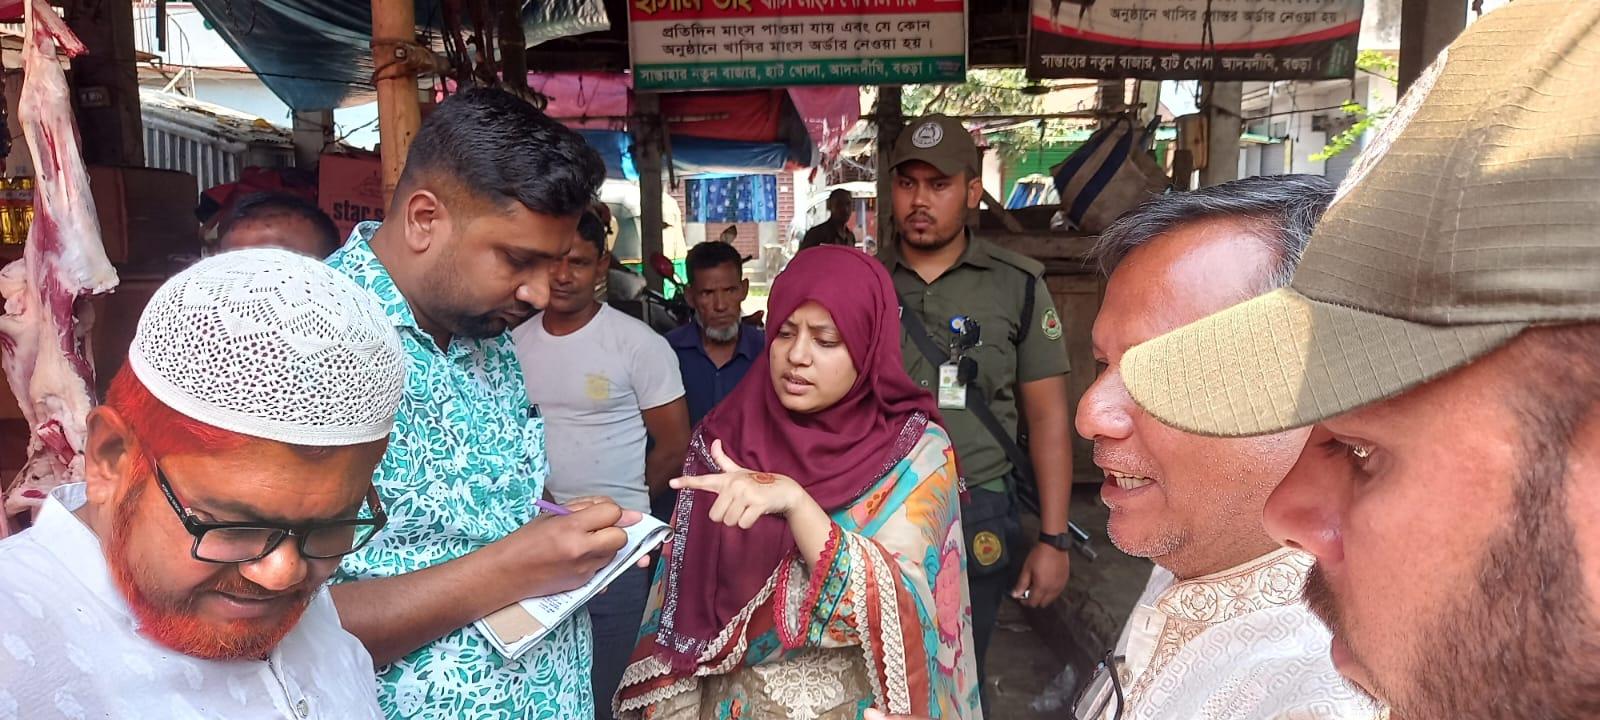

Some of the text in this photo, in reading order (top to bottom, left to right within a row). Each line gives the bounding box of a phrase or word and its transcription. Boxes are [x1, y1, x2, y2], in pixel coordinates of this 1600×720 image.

[1110, 3, 1157, 23] অনুষ্ঠানে
[1243, 8, 1276, 23] অর্ডার
[662, 19, 931, 38] প্রতিদিন মাংস পাওয়া যায় এবং যে কোন
[662, 40, 717, 57] অনুষ্ঠানে
[723, 40, 764, 54] খাসির
[770, 40, 803, 54] মাংস
[809, 37, 847, 52] অর্ডার
[854, 37, 896, 50] নেওয়া
[1090, 54, 1116, 72] নতুন
[1160, 52, 1180, 71] হাট
[692, 66, 718, 83] নতুন
[333, 200, 371, 222] star
